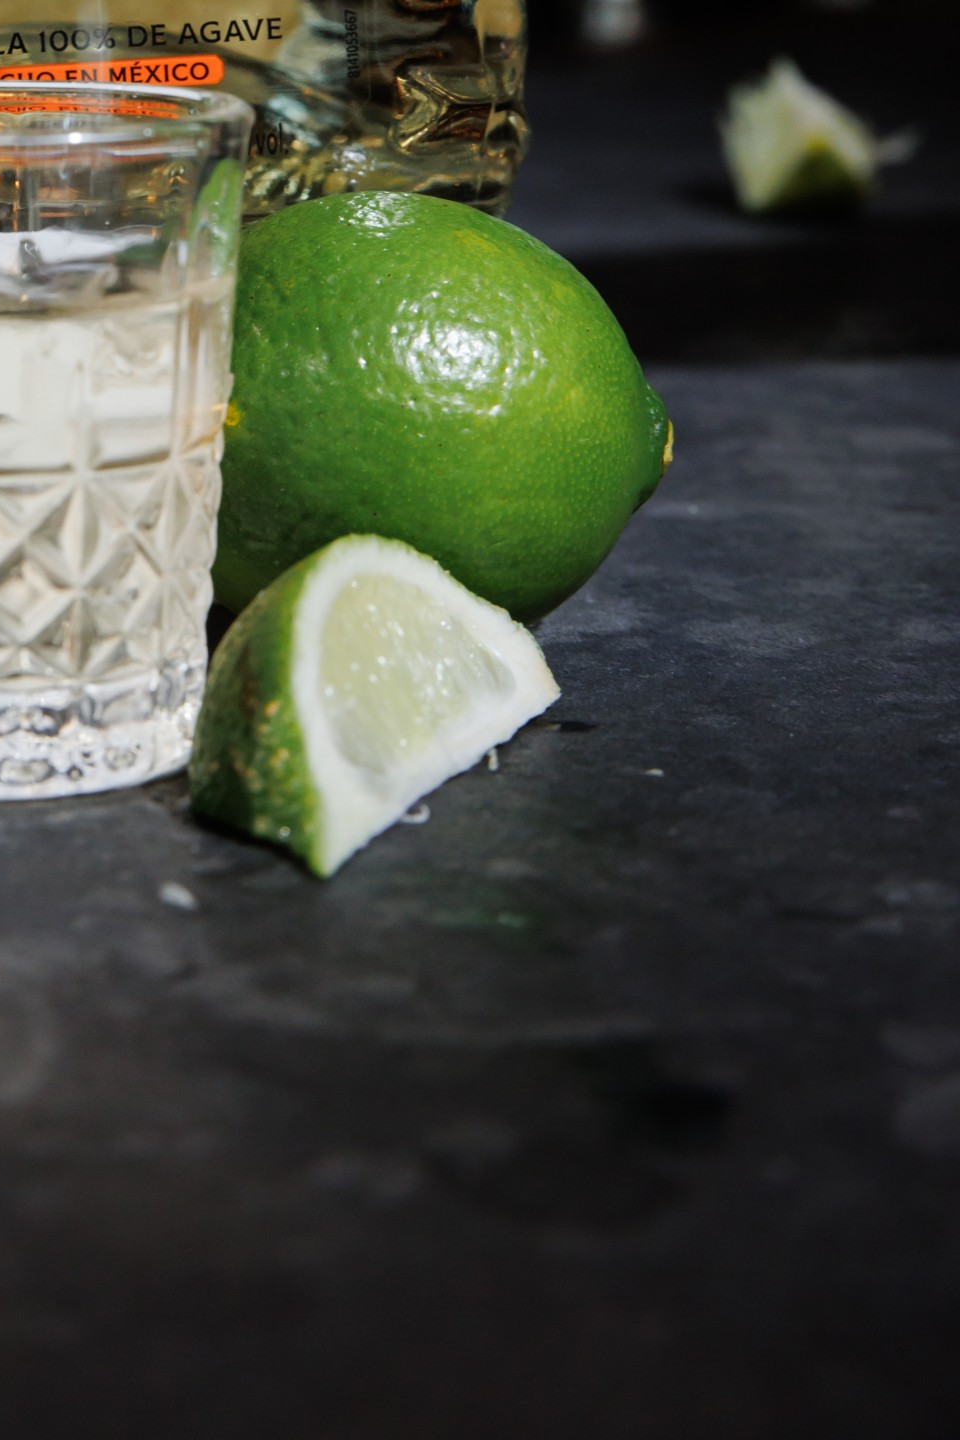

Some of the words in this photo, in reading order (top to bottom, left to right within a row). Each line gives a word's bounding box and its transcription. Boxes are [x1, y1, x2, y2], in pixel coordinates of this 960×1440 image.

[39, 26, 116, 53] 100%
[128, 23, 167, 48] DE
[178, 17, 283, 45] AGAVE
[109, 61, 210, 83] MÉXICO
